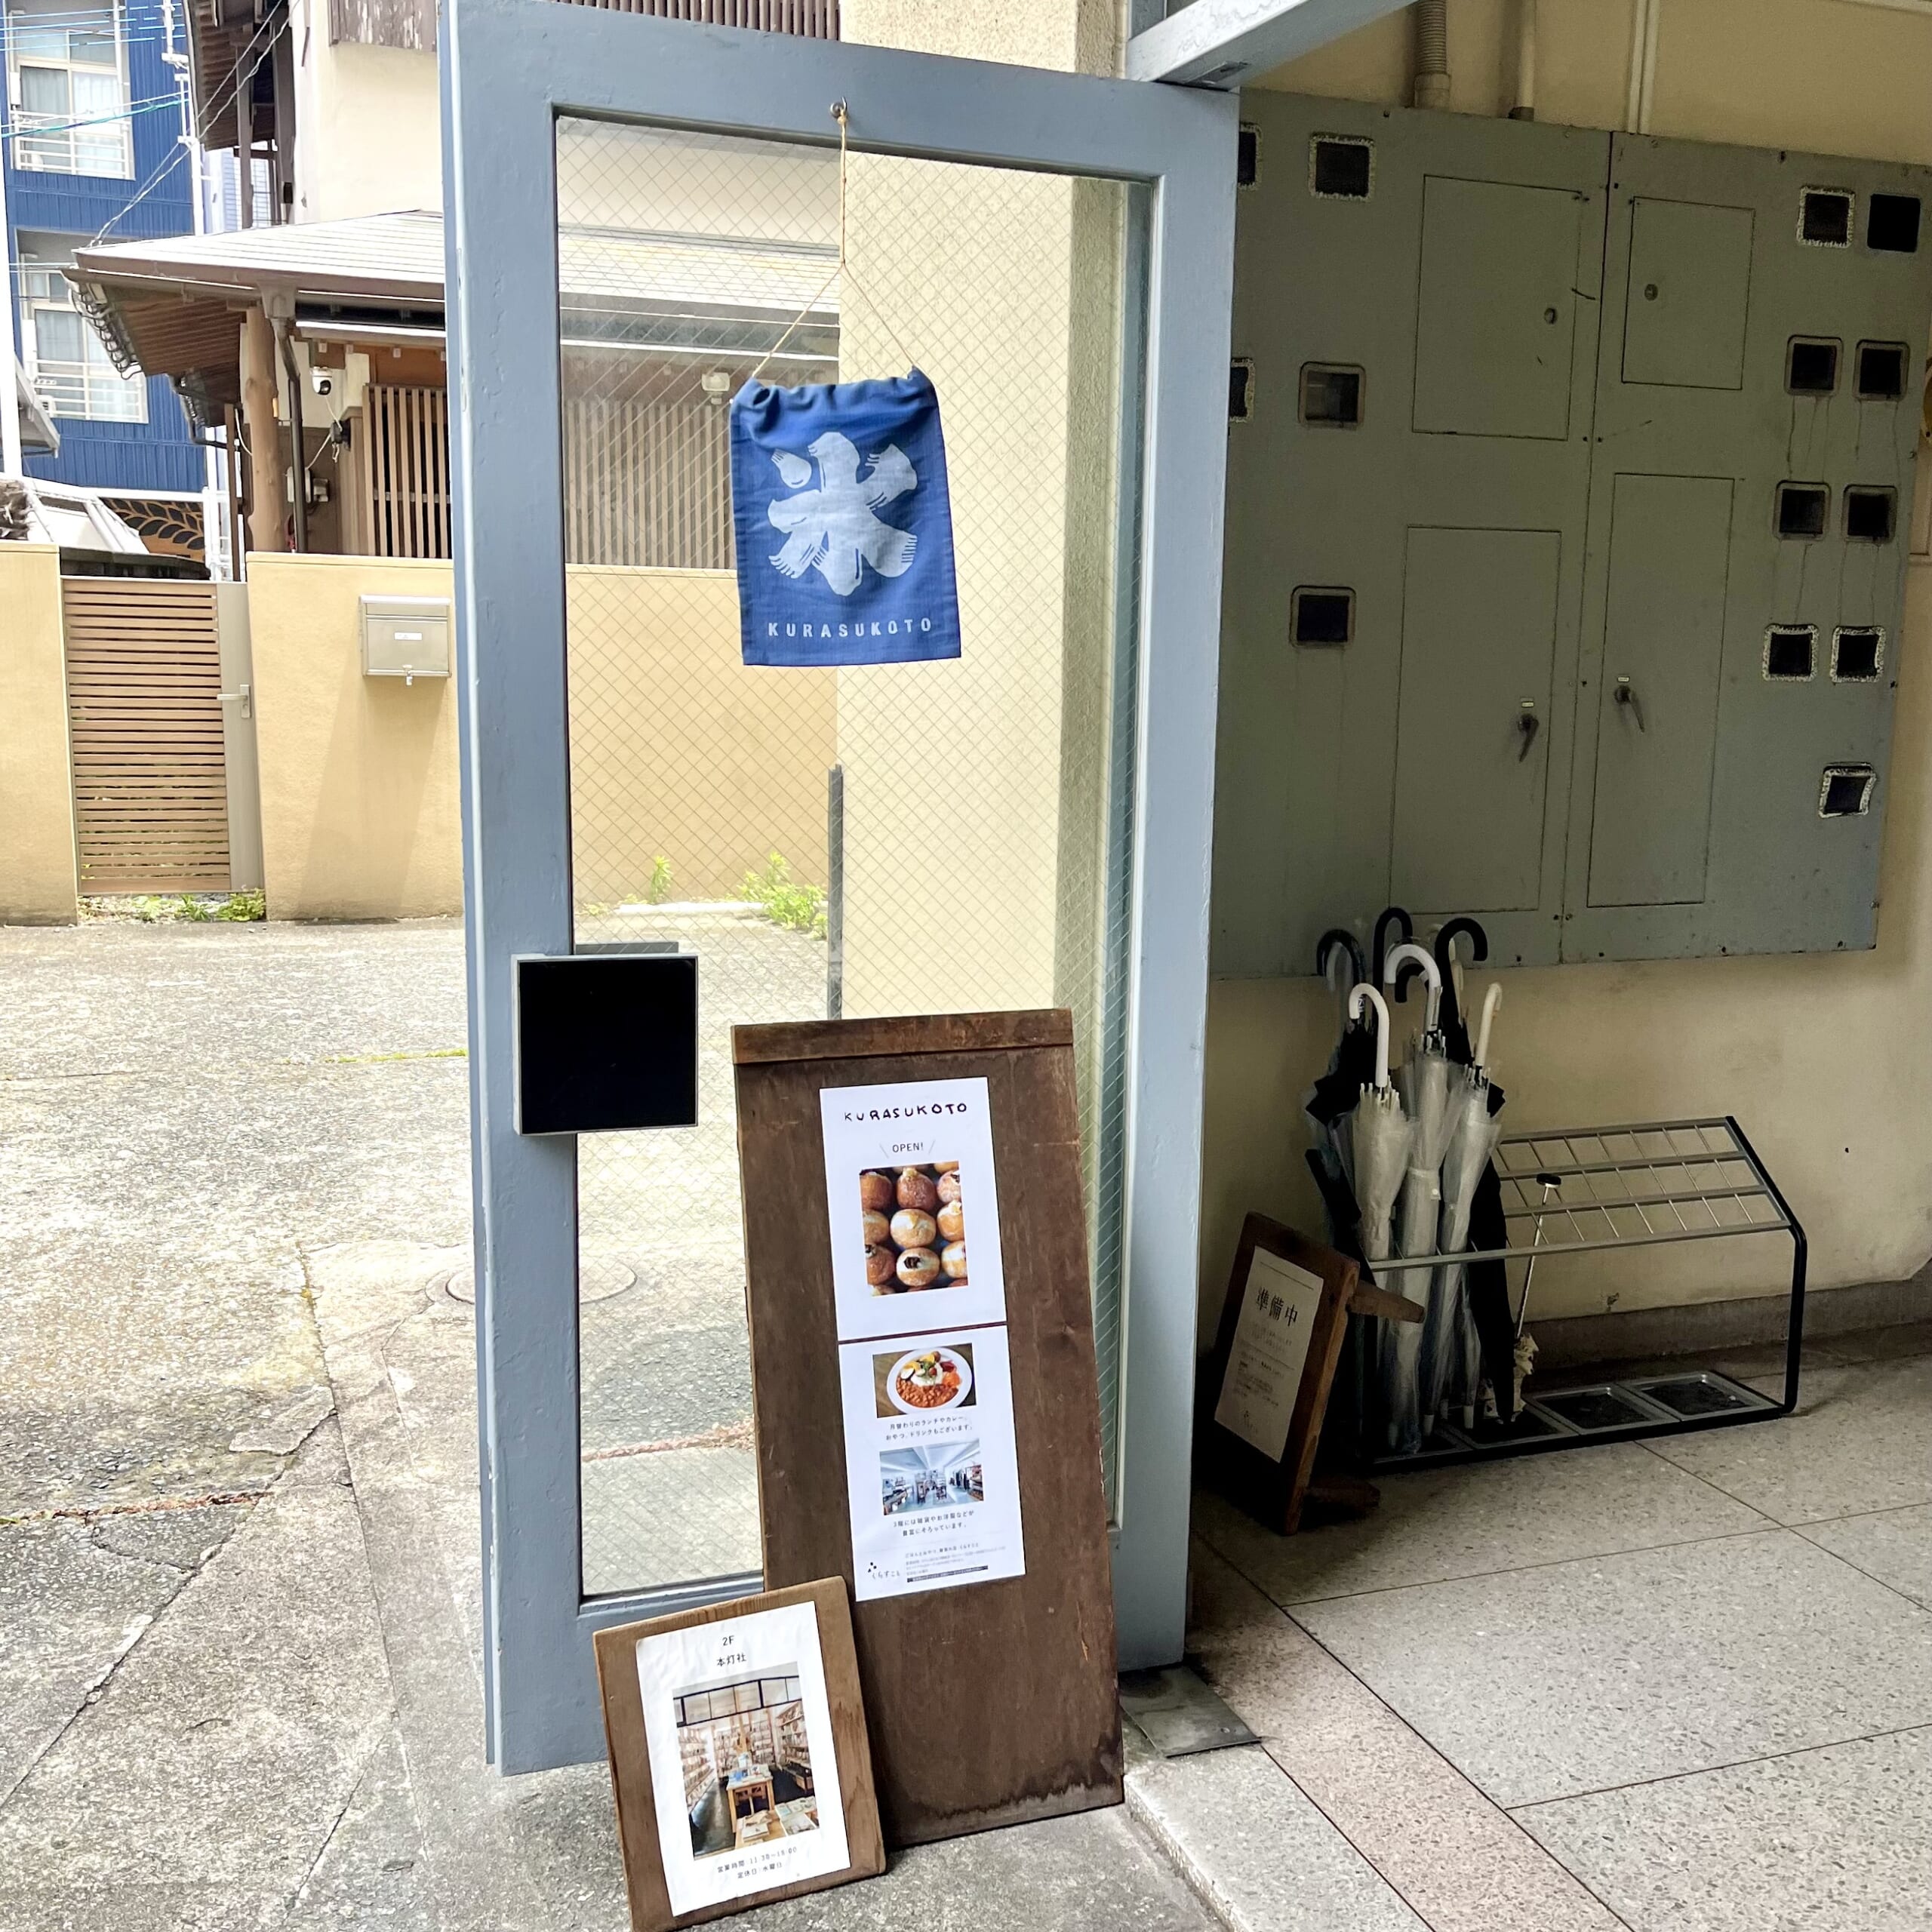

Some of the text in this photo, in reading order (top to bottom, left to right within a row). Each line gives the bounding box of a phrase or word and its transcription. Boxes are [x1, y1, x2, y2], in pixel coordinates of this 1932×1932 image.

[768, 617, 931, 638] KURASUKOTO
[844, 1103, 968, 1121] KURASUKOTO
[892, 1142, 924, 1153] OPEN!
[1256, 1286, 1298, 1327] 準備中
[722, 1635, 735, 1646] 2F
